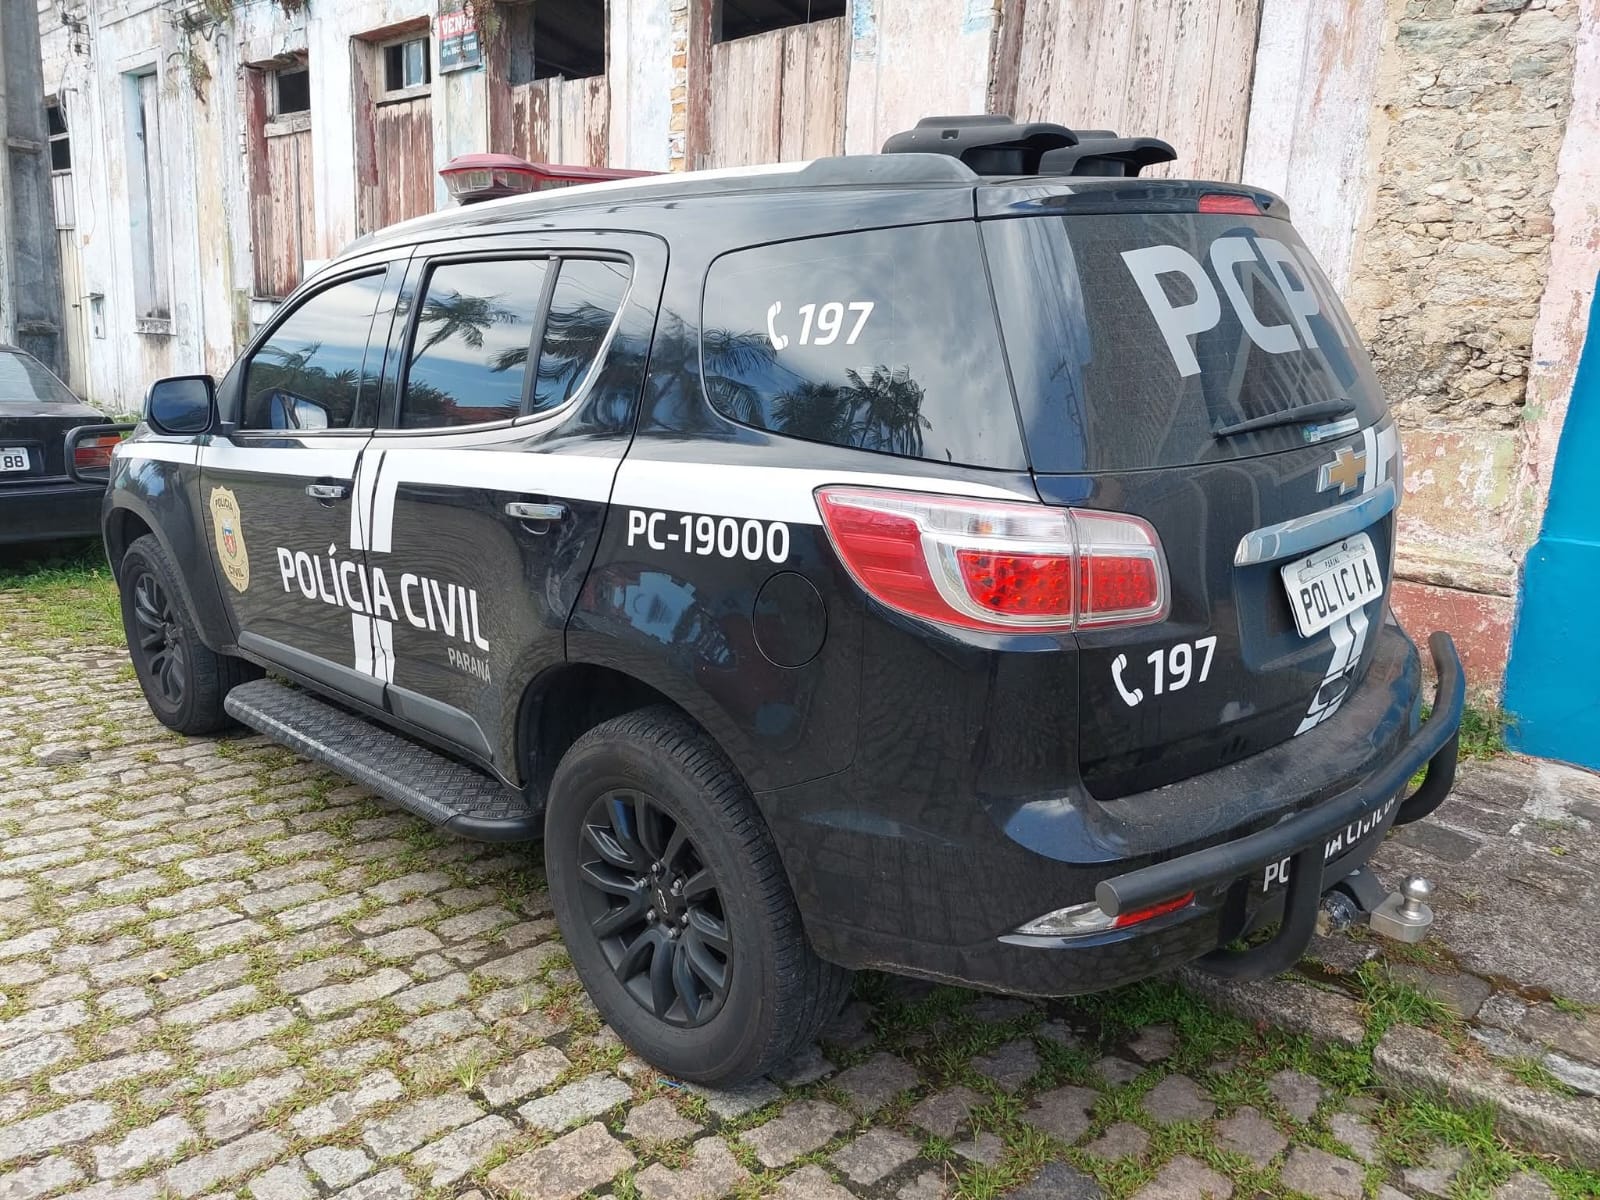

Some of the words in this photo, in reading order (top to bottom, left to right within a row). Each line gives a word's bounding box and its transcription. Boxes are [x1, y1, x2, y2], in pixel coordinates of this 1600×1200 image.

[798, 302, 875, 345] 197
[627, 510, 790, 563] PC-19000
[277, 543, 399, 621] POLÍCIA
[401, 573, 490, 651] CIVIL
[1299, 558, 1376, 625] POLICIA
[447, 647, 492, 685] PARANÁ
[1147, 636, 1217, 695] 197
